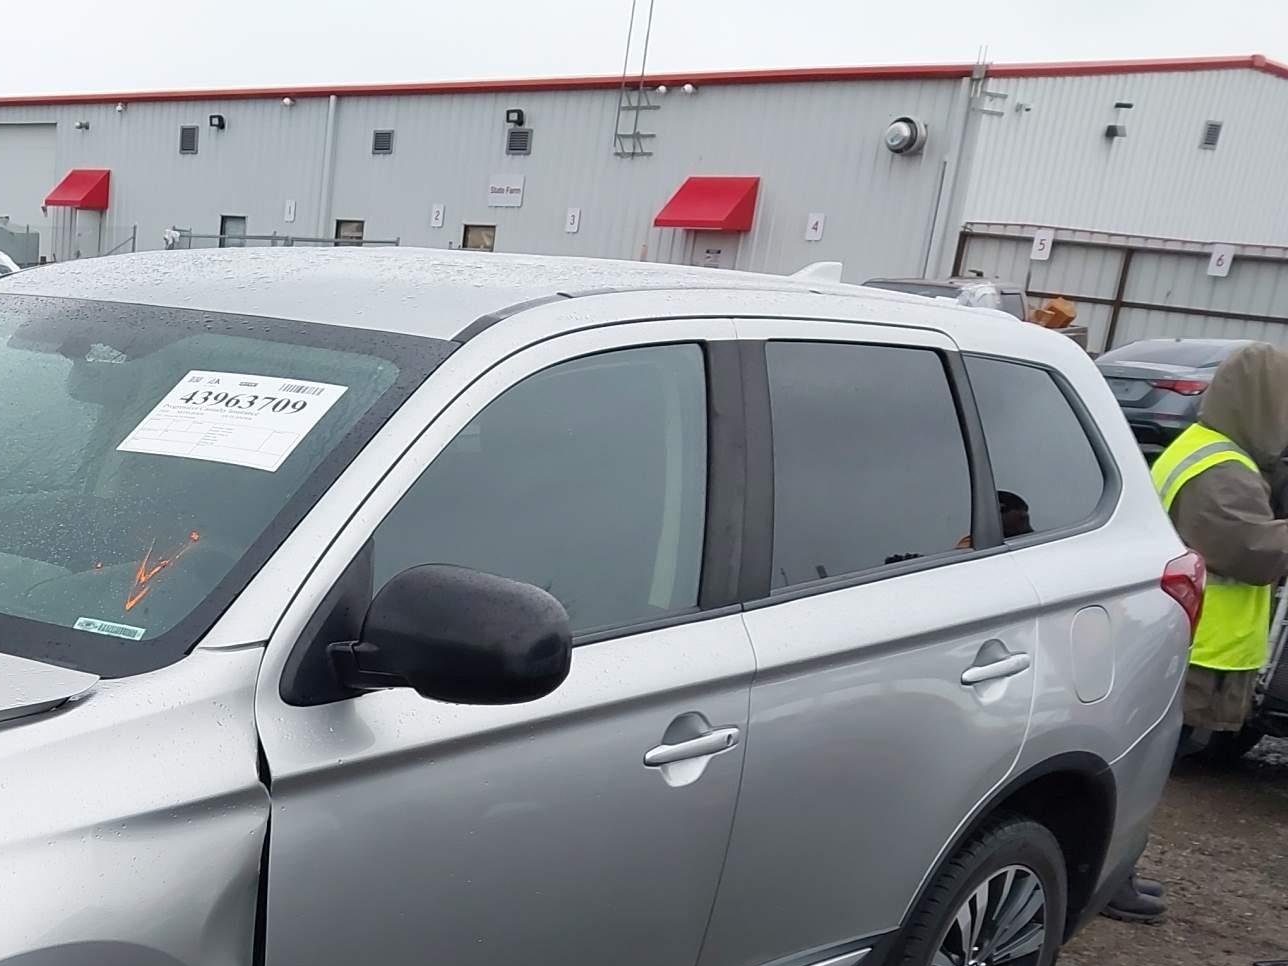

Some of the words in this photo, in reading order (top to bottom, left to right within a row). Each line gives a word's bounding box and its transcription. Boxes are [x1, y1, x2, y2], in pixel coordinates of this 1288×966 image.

[490, 185, 505, 194] State
[506, 186, 521, 194] Farm
[434, 210, 441, 220] 2
[569, 214, 576, 225] 3
[811, 221, 819, 232] 4
[1038, 238, 1047, 251] 5
[1216, 254, 1225, 268] 6
[179, 390, 308, 415] 43963709
